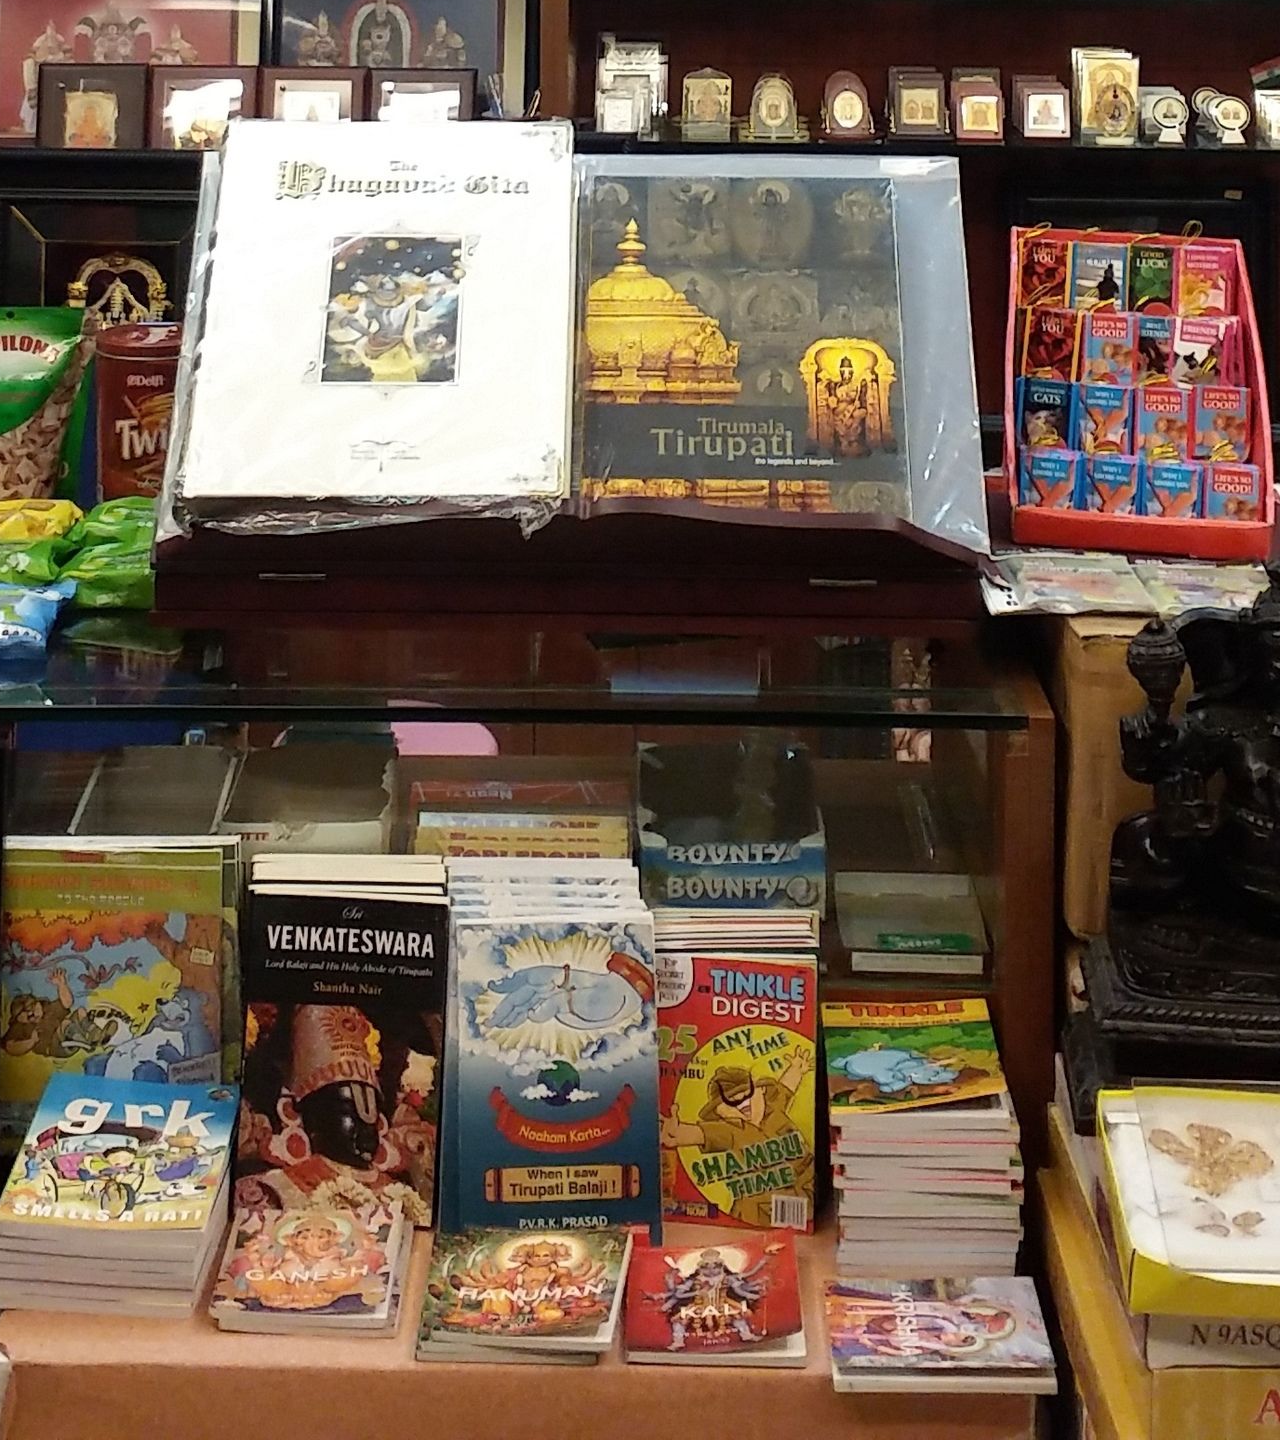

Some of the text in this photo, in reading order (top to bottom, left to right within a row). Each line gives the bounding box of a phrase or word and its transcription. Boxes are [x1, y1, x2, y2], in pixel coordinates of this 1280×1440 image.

[1032, 253, 1056, 264] YOU
[1041, 322, 1064, 334] YOU
[1092, 327, 1127, 338] GOOD!
[1033, 393, 1061, 405] CATS
[1144, 402, 1181, 413] GOOD!
[1203, 399, 1240, 410] GOOD!
[697, 417, 785, 436] Tirumala
[649, 427, 794, 461] Tirupati
[1214, 482, 1252, 494] GOOD!
[666, 842, 789, 865] BOUNTY
[666, 875, 781, 901] BOUNTY
[267, 924, 435, 959] VENKATESWARA
[265, 959, 285, 970] Lord
[308, 961, 324, 971] and
[326, 961, 339, 972] His
[340, 962, 361, 973] Holy
[361, 963, 386, 974] Abode
[387, 965, 399, 976] of
[313, 981, 383, 996] Shantha Nair
[710, 968, 805, 1002] TINKLE
[712, 996, 806, 1024] DIGEST
[846, 1001, 966, 1017] TINKLE
[711, 1027, 752, 1056] ANY
[746, 1031, 790, 1060] TIME
[768, 1057, 784, 1073] IS
[57, 1098, 216, 1138] grk
[690, 1131, 806, 1187] SHAMBU
[527, 1168, 563, 1180] When
[573, 1168, 599, 1178] saw
[727, 1166, 795, 1199] TIME
[509, 1182, 564, 1199] Tirupati
[569, 1180, 608, 1198] Balaji
[12, 1203, 203, 1223] SMELLS A RAT!
[562, 1215, 609, 1228] PRASAD
[244, 1263, 369, 1284] GANESH
[457, 1279, 606, 1303] HANUMAN
[679, 1300, 749, 1321] KALI
[891, 1291, 924, 1358] KRISHNA
[1189, 1323, 1211, 1347] N
